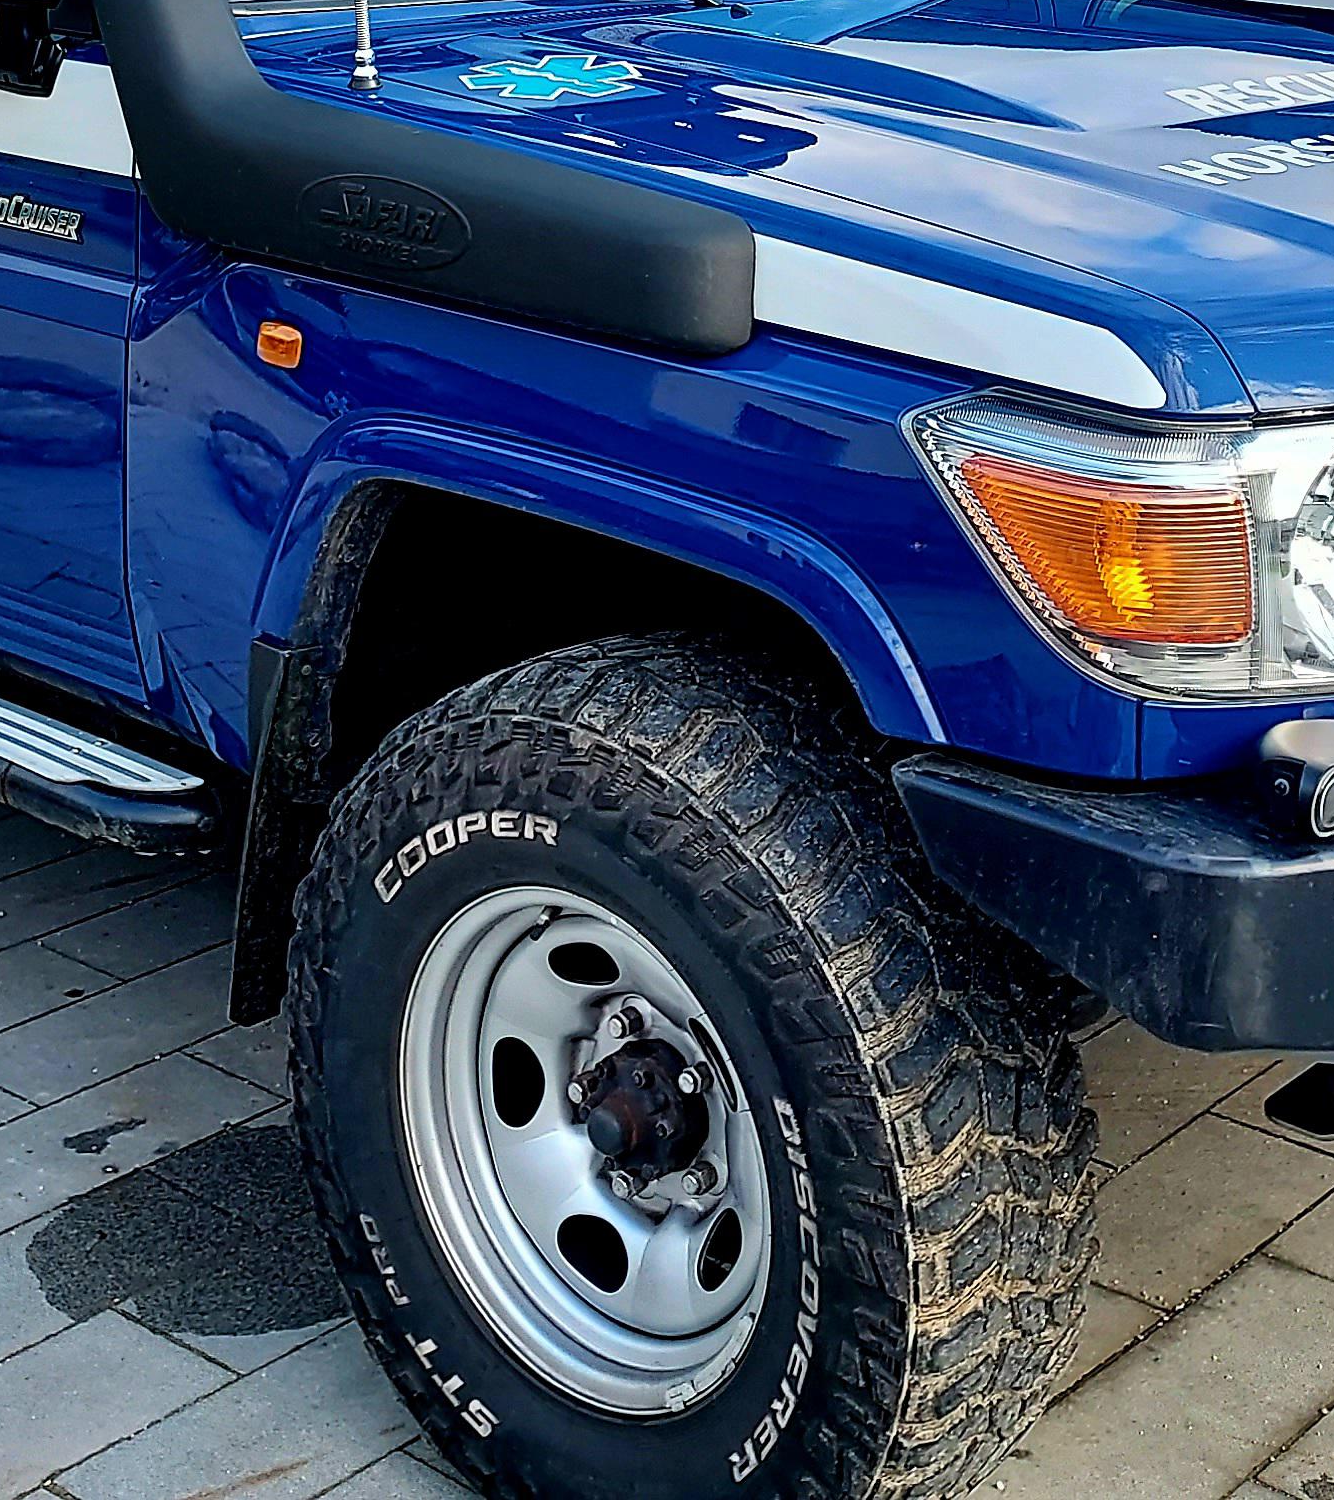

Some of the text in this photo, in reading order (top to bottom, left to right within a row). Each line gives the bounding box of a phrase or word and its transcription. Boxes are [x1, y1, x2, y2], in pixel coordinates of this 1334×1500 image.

[373, 810, 560, 902] COOPER
[728, 1097, 822, 1484] DISCOVERER
[404, 1332, 500, 1438] STT
